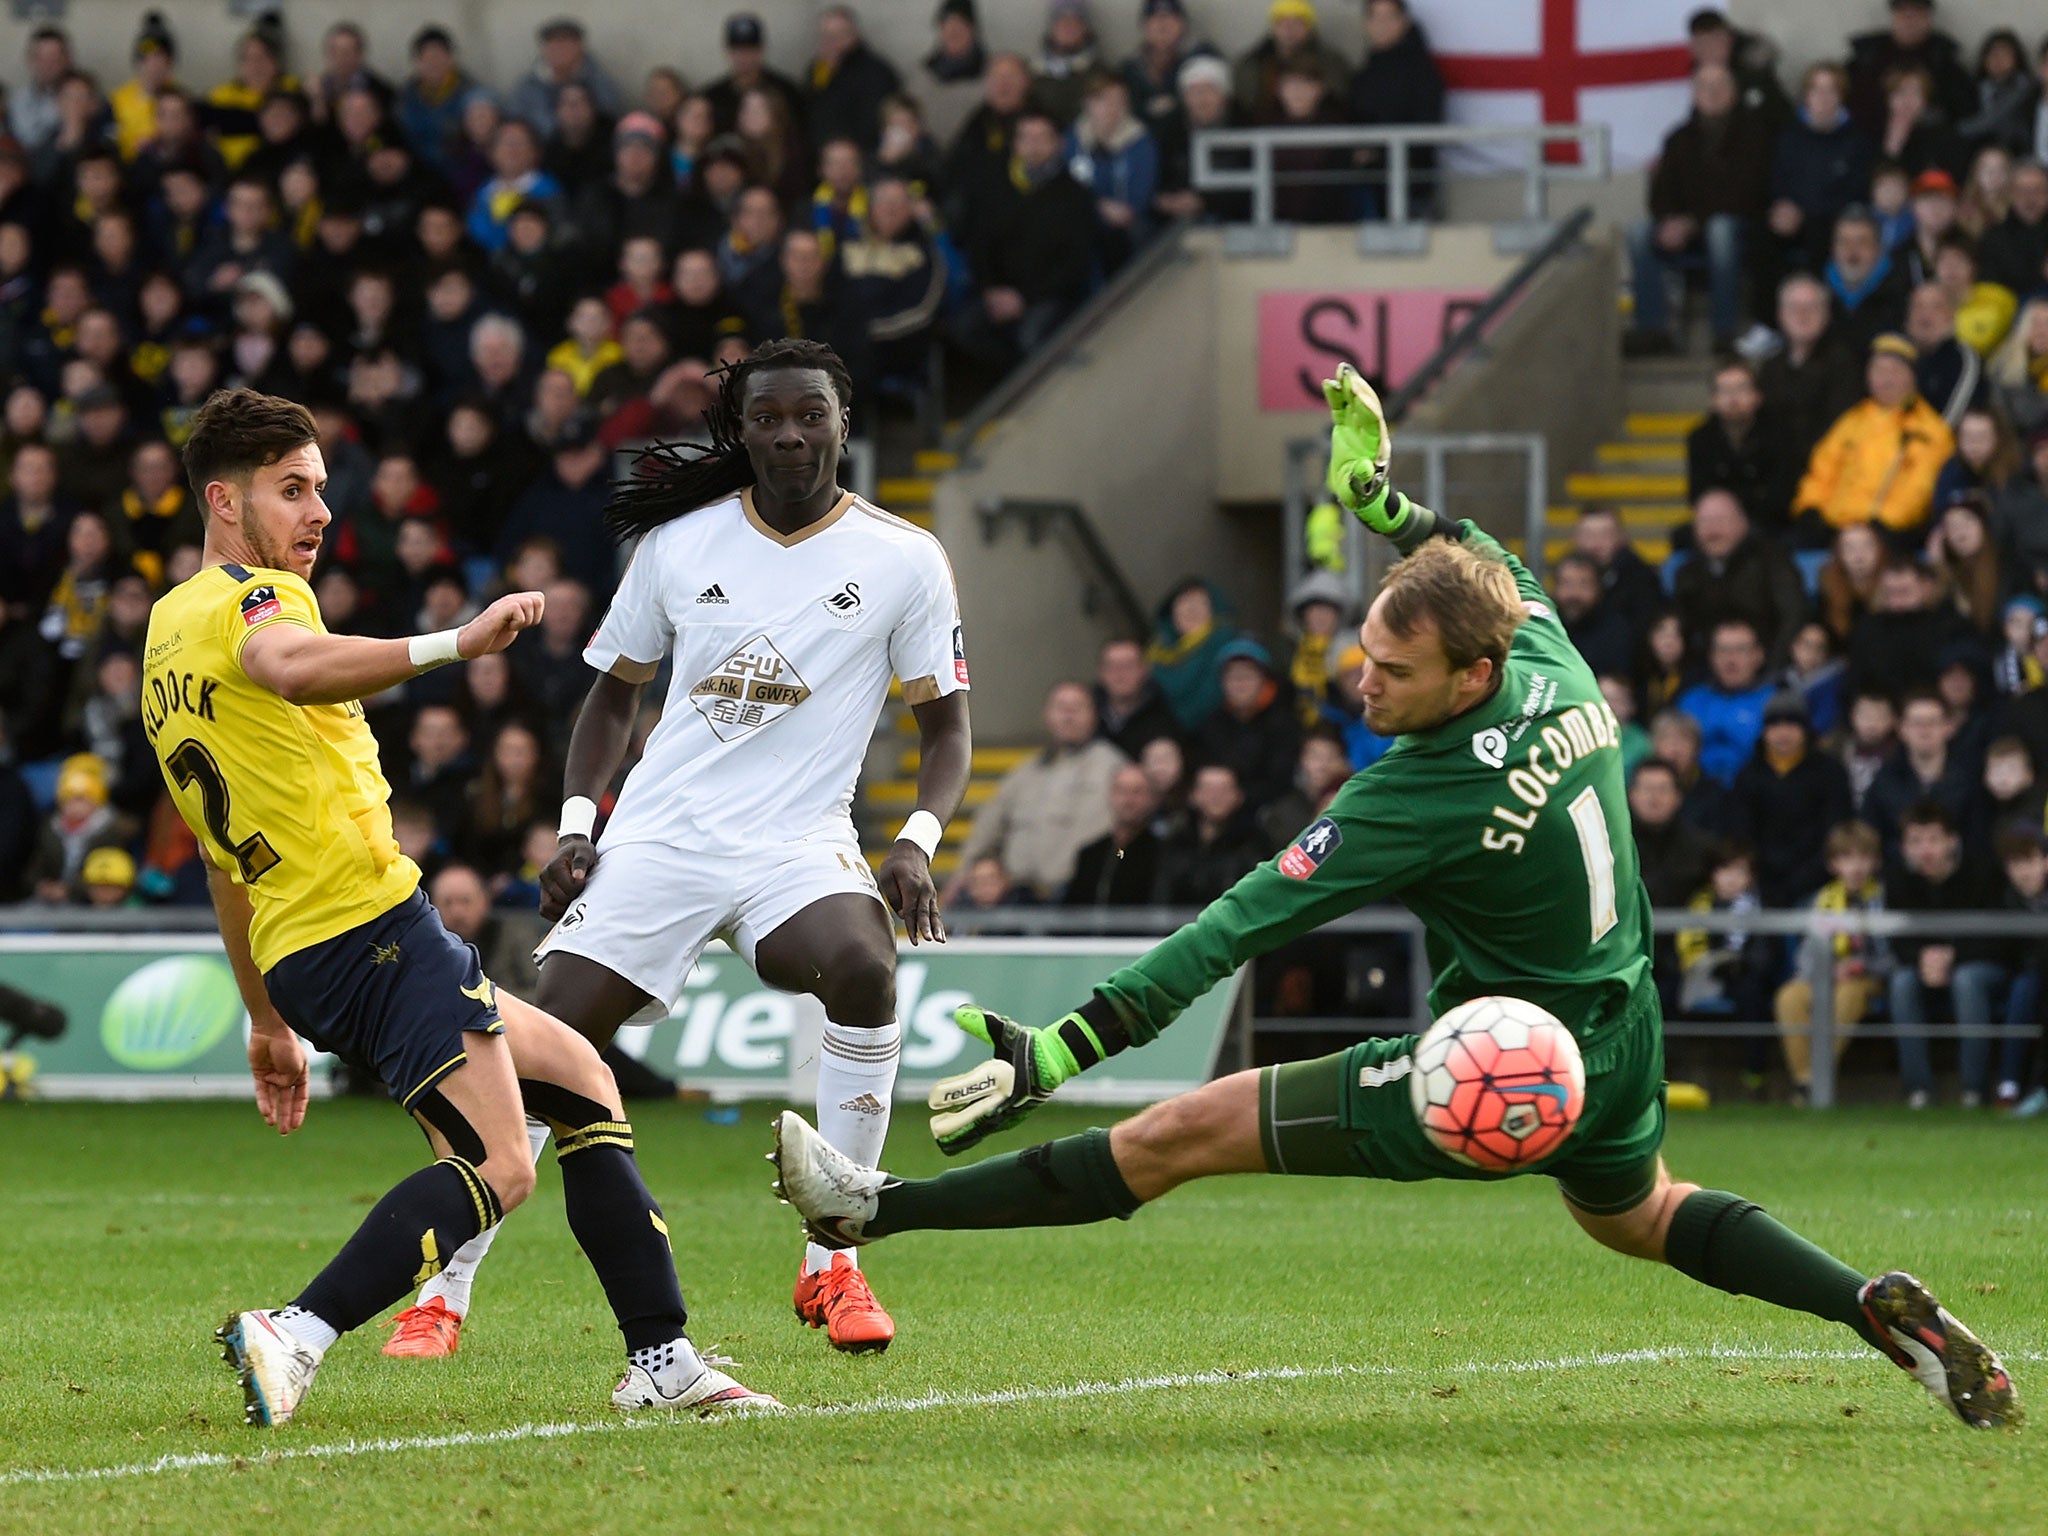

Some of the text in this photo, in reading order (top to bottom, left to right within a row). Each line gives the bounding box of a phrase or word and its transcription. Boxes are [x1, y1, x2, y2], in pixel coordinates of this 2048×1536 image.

[695, 595, 730, 605] adidas
[755, 685, 801, 703] GWFX
[710, 699, 766, 727] 金道
[165, 738, 283, 884] 2
[1566, 785, 1619, 945] 1
[943, 1075, 997, 1102] reusch
[838, 1102, 887, 1116] adidas
